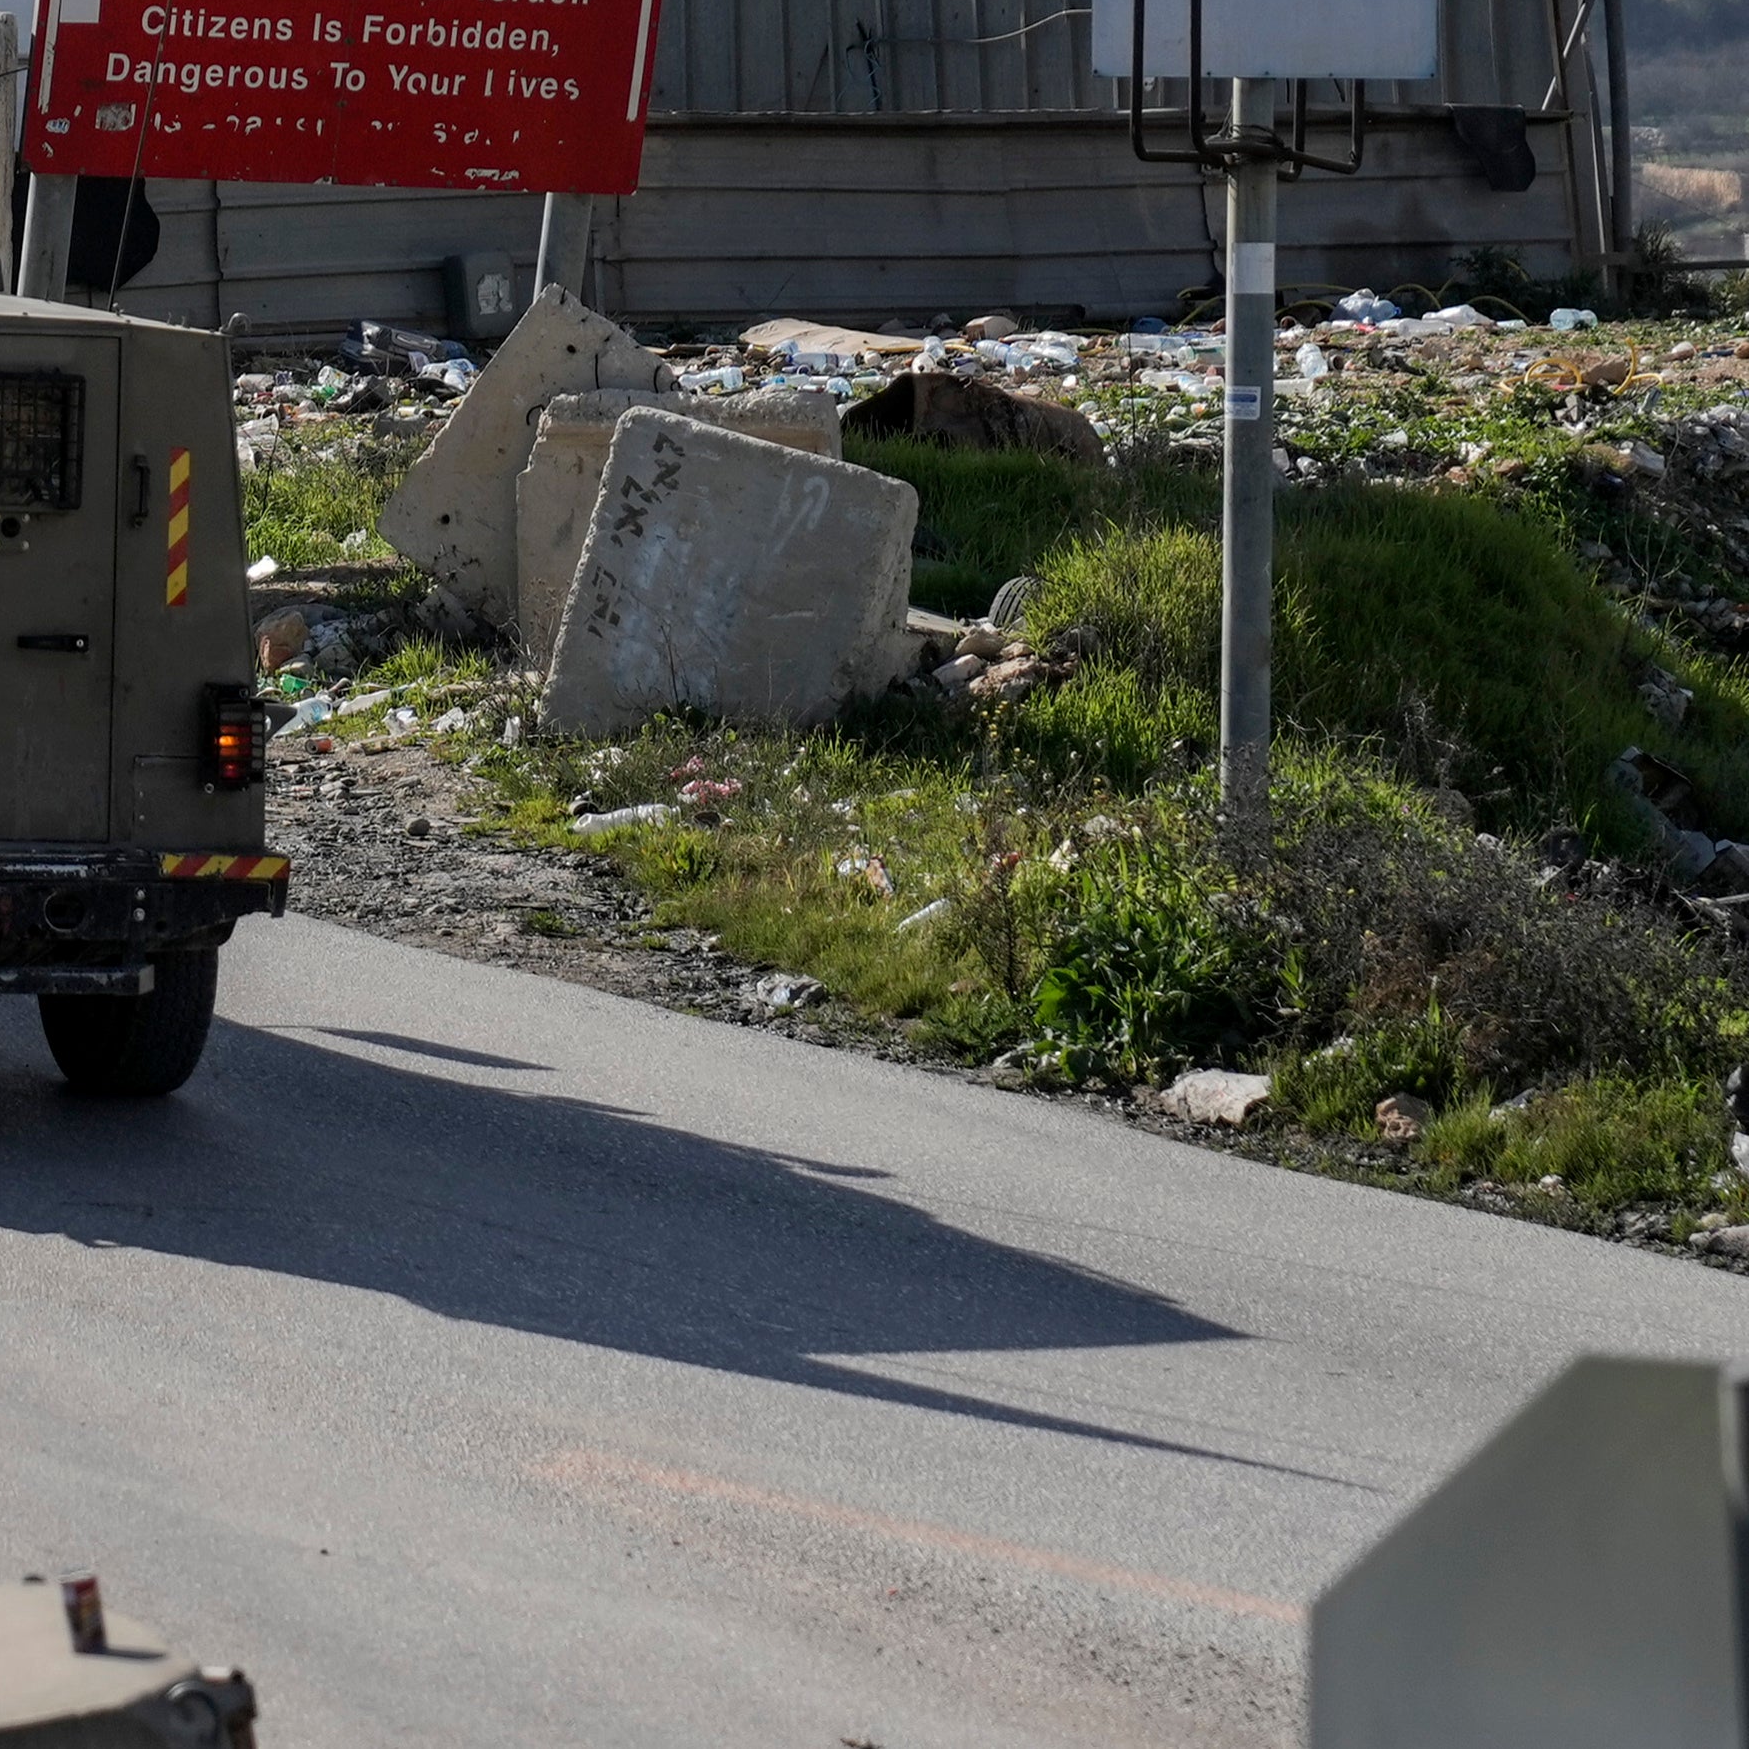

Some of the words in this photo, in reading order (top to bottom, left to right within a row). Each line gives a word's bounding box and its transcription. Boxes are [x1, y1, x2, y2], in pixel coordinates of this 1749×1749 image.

[141, 5, 294, 42] Citizens
[313, 13, 343, 43] Is
[362, 15, 561, 57] Forbidden,
[105, 52, 310, 93] Dangerous
[330, 62, 368, 92] To
[388, 64, 467, 98] Your
